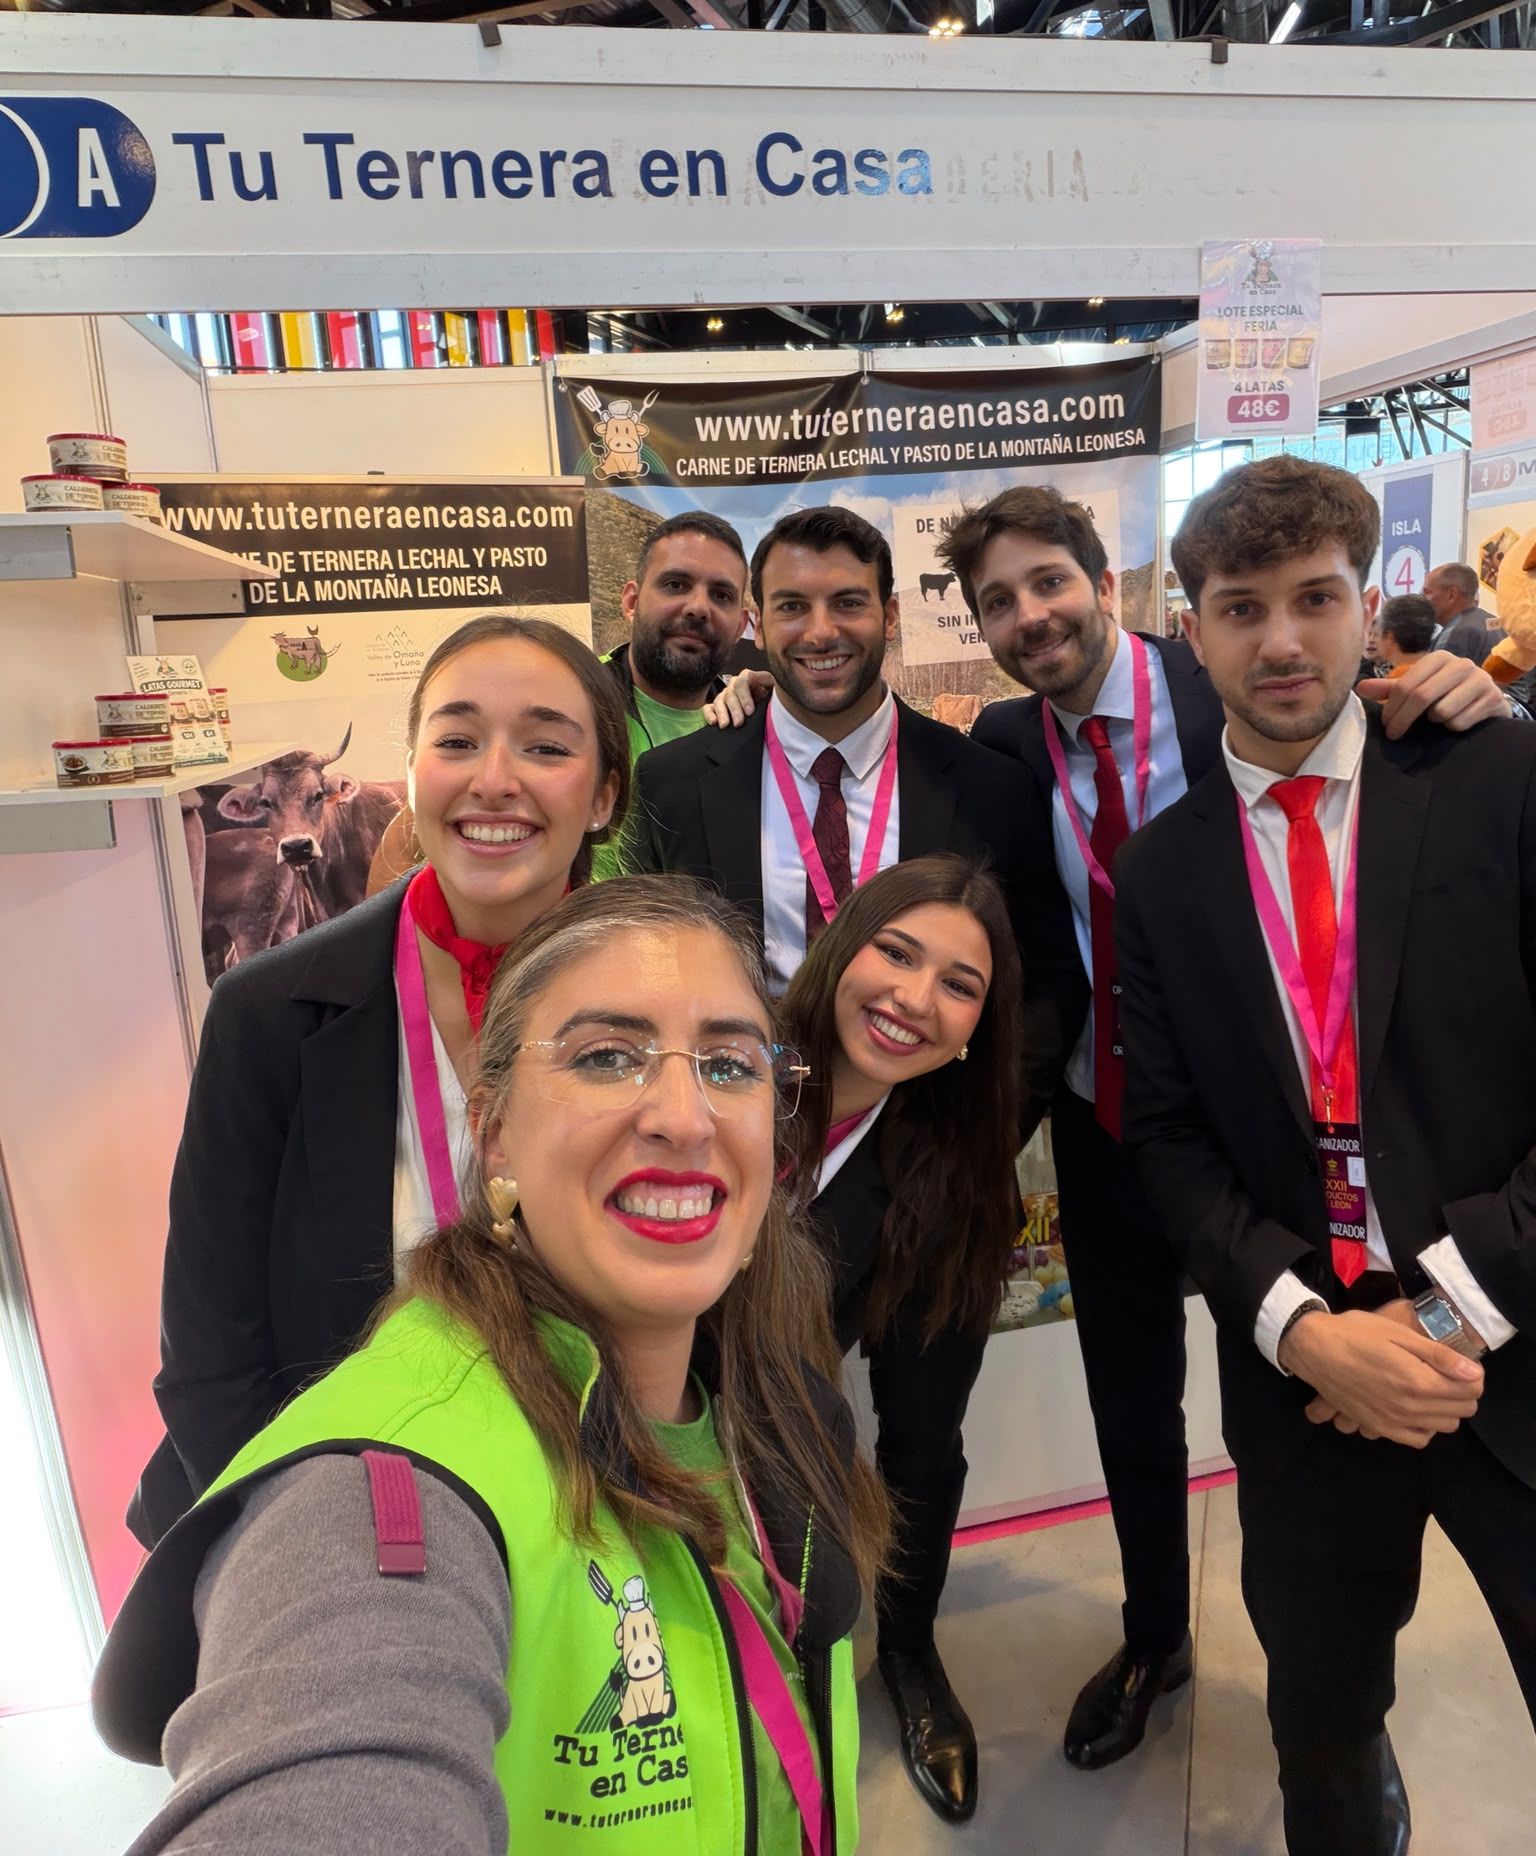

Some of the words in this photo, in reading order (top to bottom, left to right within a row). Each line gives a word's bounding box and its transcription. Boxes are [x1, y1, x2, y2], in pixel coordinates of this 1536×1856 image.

[78, 127, 121, 208] A
[172, 133, 279, 201] Tu
[303, 133, 614, 200] Ternera
[640, 149, 728, 198] en
[756, 131, 934, 197] Casa
[1217, 306, 1246, 318] LOTE
[1249, 304, 1304, 317] ESPECIAL
[1244, 320, 1278, 332] FERIA
[1234, 381, 1243, 393] 4
[1245, 380, 1285, 393] LATAS
[695, 393, 1126, 442] www.tuterneraencasa.com
[1237, 399, 1280, 418] 48€
[676, 457, 735, 477] CARNE
[738, 457, 756, 475] DE
[759, 451, 827, 475] TERNERA
[830, 447, 889, 468] LECHAL
[890, 446, 900, 464] Y
[904, 443, 952, 464] PASTO
[955, 442, 975, 461] DE
[979, 440, 998, 459] LA
[1001, 432, 1074, 458] MONTAÑA
[1076, 427, 1147, 453] LEONESA
[160, 501, 574, 531] www.tuterneraencasa.com
[916, 517, 935, 533] DE
[1391, 518, 1422, 537] ISLA
[267, 551, 297, 573] DE
[299, 549, 394, 573] TERNERA
[397, 548, 470, 570] LECHAL
[472, 548, 487, 568] Y
[490, 546, 548, 568] PASTO
[249, 581, 279, 605] DE
[282, 579, 310, 603] LA
[314, 572, 414, 601] MONTAÑA
[417, 575, 503, 598] LEONESA
[1394, 556, 1415, 594] 4
[937, 615, 961, 628] SIN
[143, 682, 166, 692] LATAS
[167, 679, 201, 690] GOURMET
[1013, 1216, 1050, 1247] XII
[553, 1733, 599, 1767] Tu
[589, 1771, 627, 1799] en
[637, 1754, 689, 1787] Cas
